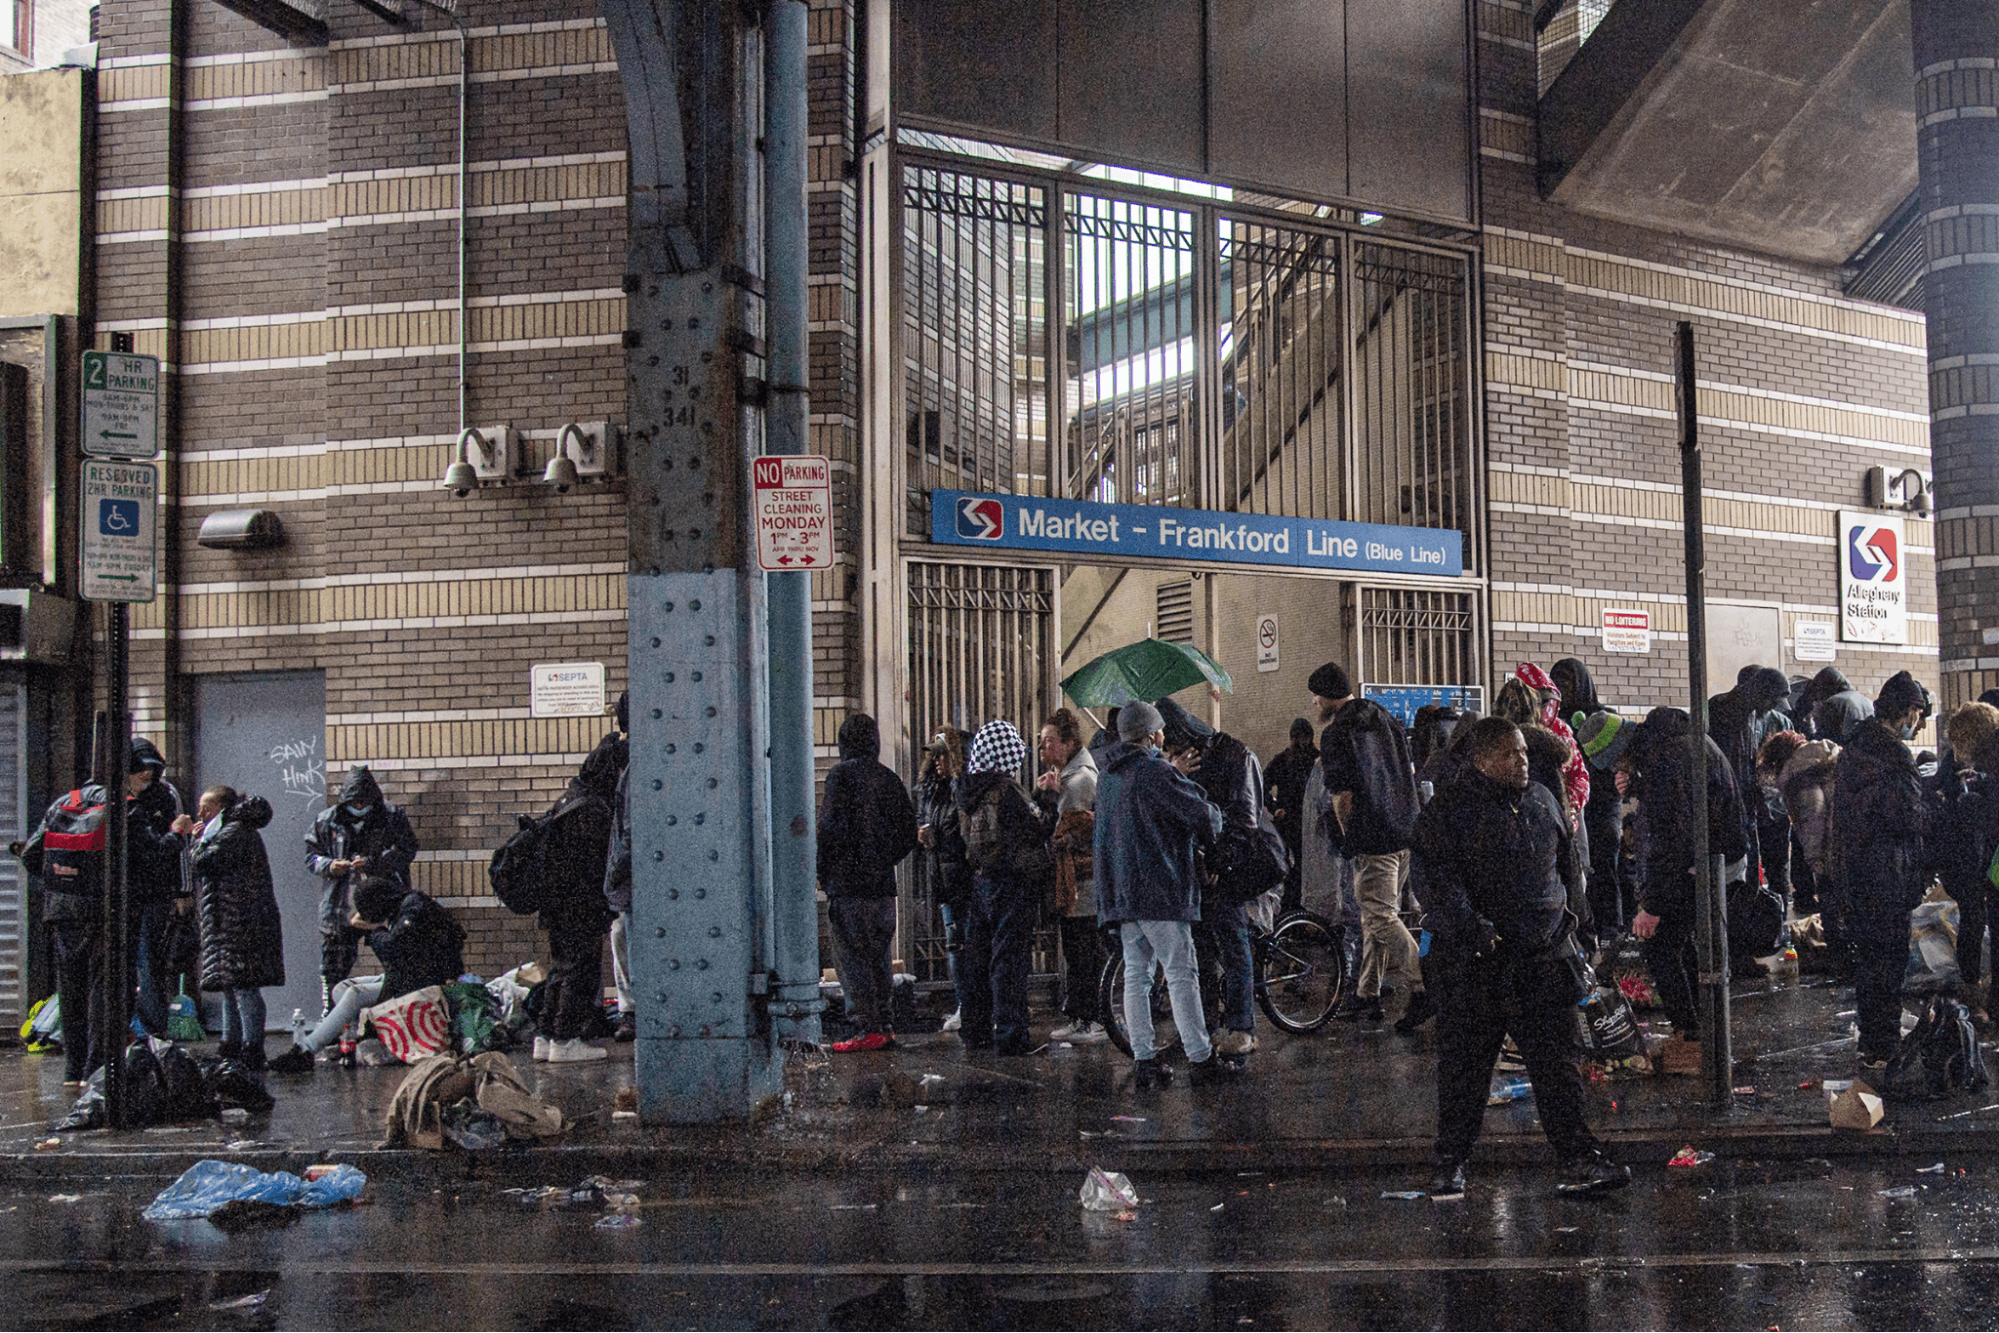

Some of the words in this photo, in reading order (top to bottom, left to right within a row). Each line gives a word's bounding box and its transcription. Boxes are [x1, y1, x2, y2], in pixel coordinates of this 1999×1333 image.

[89, 358, 103, 383] 2
[124, 361, 142, 373] HR
[672, 366, 689, 385] 31
[109, 374, 155, 391] PARKING
[663, 406, 695, 429] 341
[90, 466, 150, 485] RESERVED
[756, 462, 780, 484] NO
[784, 466, 825, 480] PARKING
[87, 482, 107, 496] 2HR
[112, 484, 152, 499] PARKING
[772, 491, 813, 501] STREET
[764, 504, 822, 514] CLEANING
[762, 516, 826, 530] MONDAY
[771, 532, 788, 545] 1PM
[799, 532, 820, 544] 3PM
[1019, 508, 1120, 542] Market
[1159, 518, 1290, 555] Frankford
[1307, 529, 1358, 559] Line
[1365, 541, 1403, 561] (Blue
[1410, 546, 1446, 566] Line)
[1847, 584, 1900, 605] Allegheny
[1847, 603, 1887, 619] Station
[1615, 616, 1646, 628] LOITERING
[559, 672, 588, 682] SEPTA
